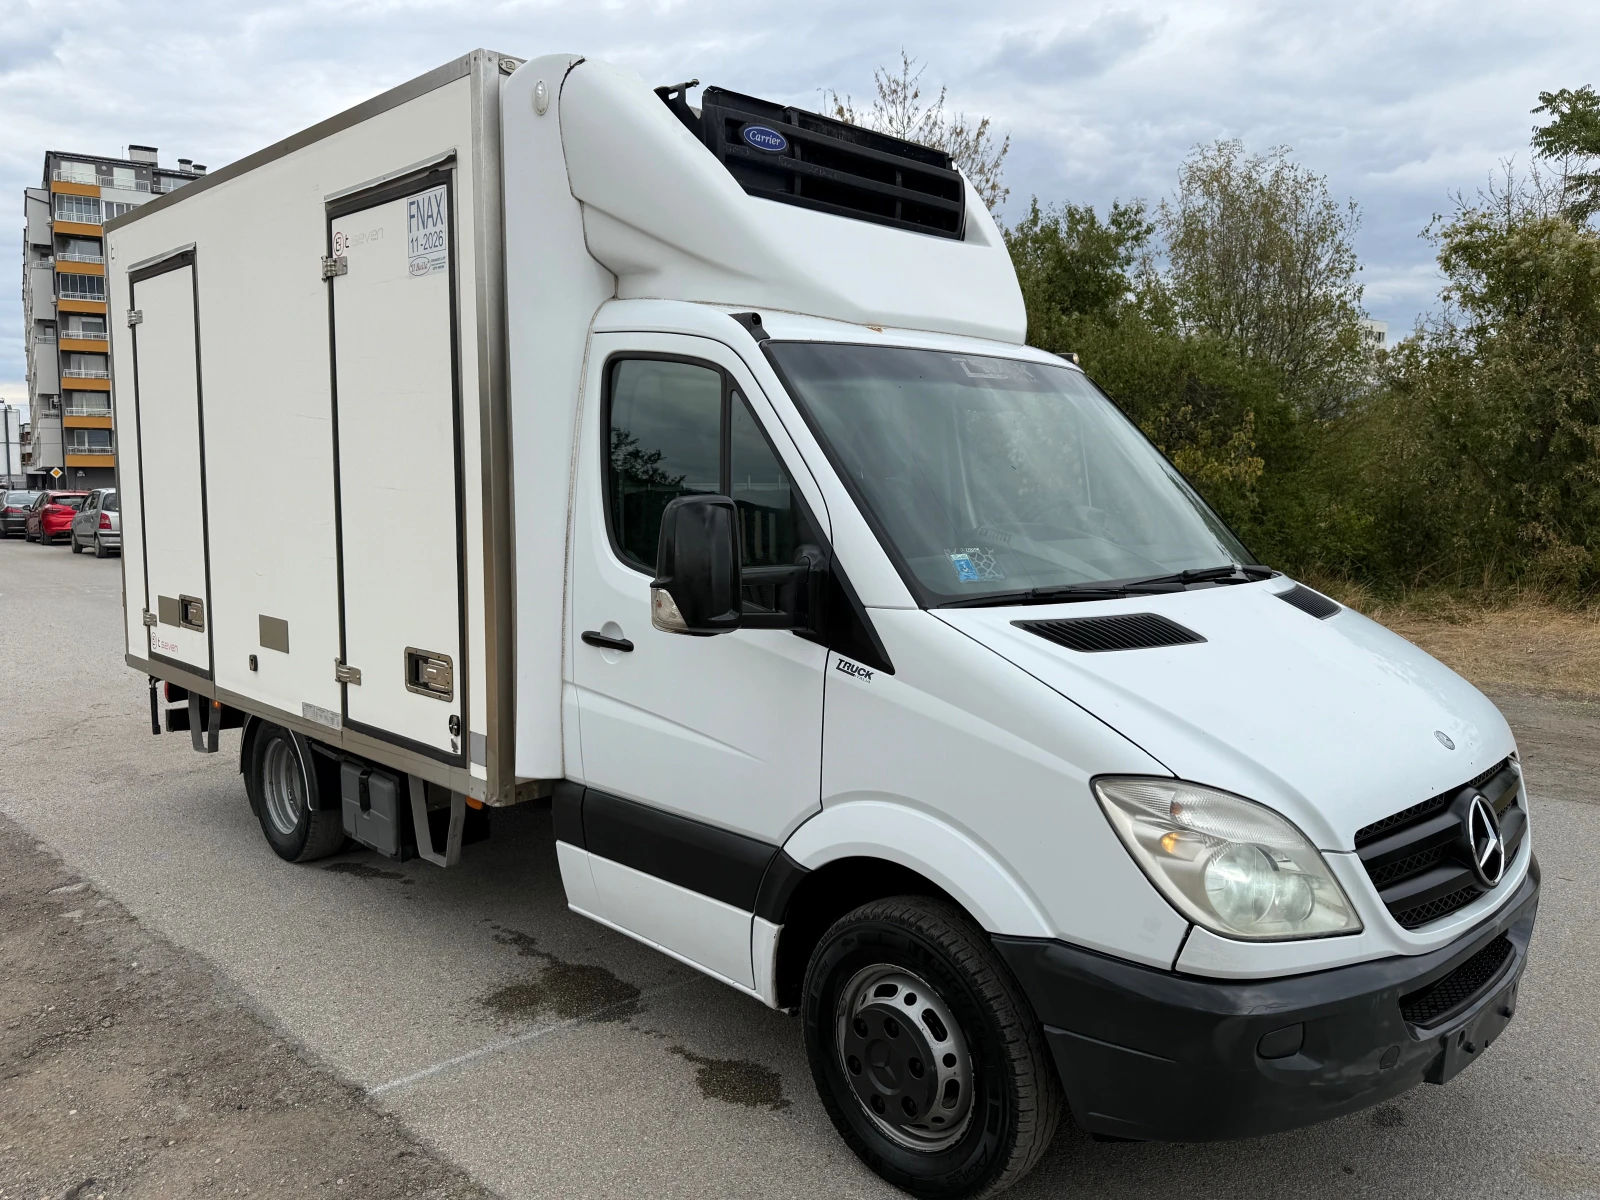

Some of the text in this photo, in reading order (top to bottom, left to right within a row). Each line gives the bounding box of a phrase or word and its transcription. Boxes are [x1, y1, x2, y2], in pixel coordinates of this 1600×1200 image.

[749, 130, 781, 146] Carrier
[409, 192, 444, 234] FNAX
[410, 231, 444, 254] 11-2026
[836, 658, 875, 681] TRUCK
